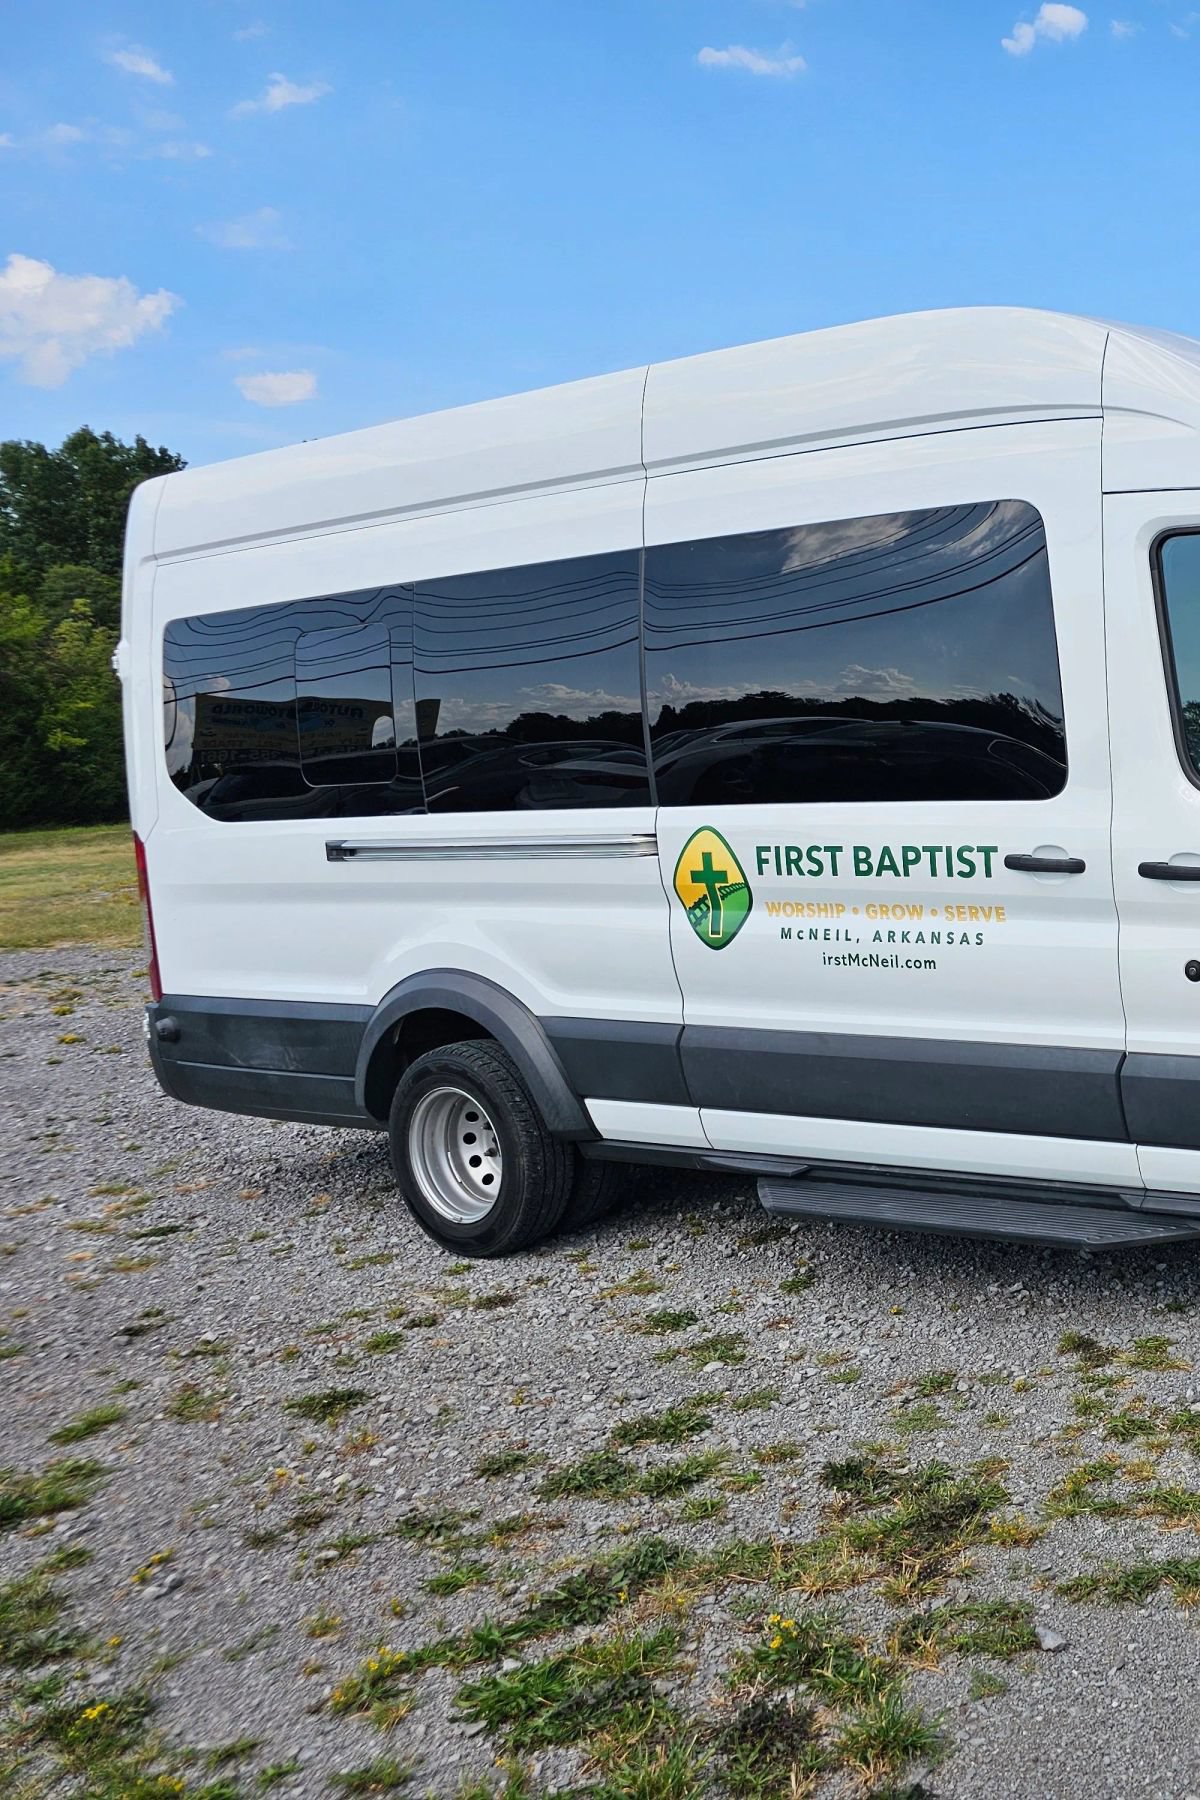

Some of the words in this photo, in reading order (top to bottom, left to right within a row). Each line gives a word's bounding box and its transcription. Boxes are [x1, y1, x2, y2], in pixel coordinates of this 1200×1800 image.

[755, 844, 844, 878] FIRST
[852, 844, 999, 879] BAPTIST
[765, 901, 846, 918] WORSHIP
[865, 903, 924, 920] GROW
[943, 904, 1007, 923] SERVE
[780, 927, 861, 944] McNEIL,
[872, 929, 985, 946] ARKANSAS
[822, 951, 937, 970] irstMcNeil.com
